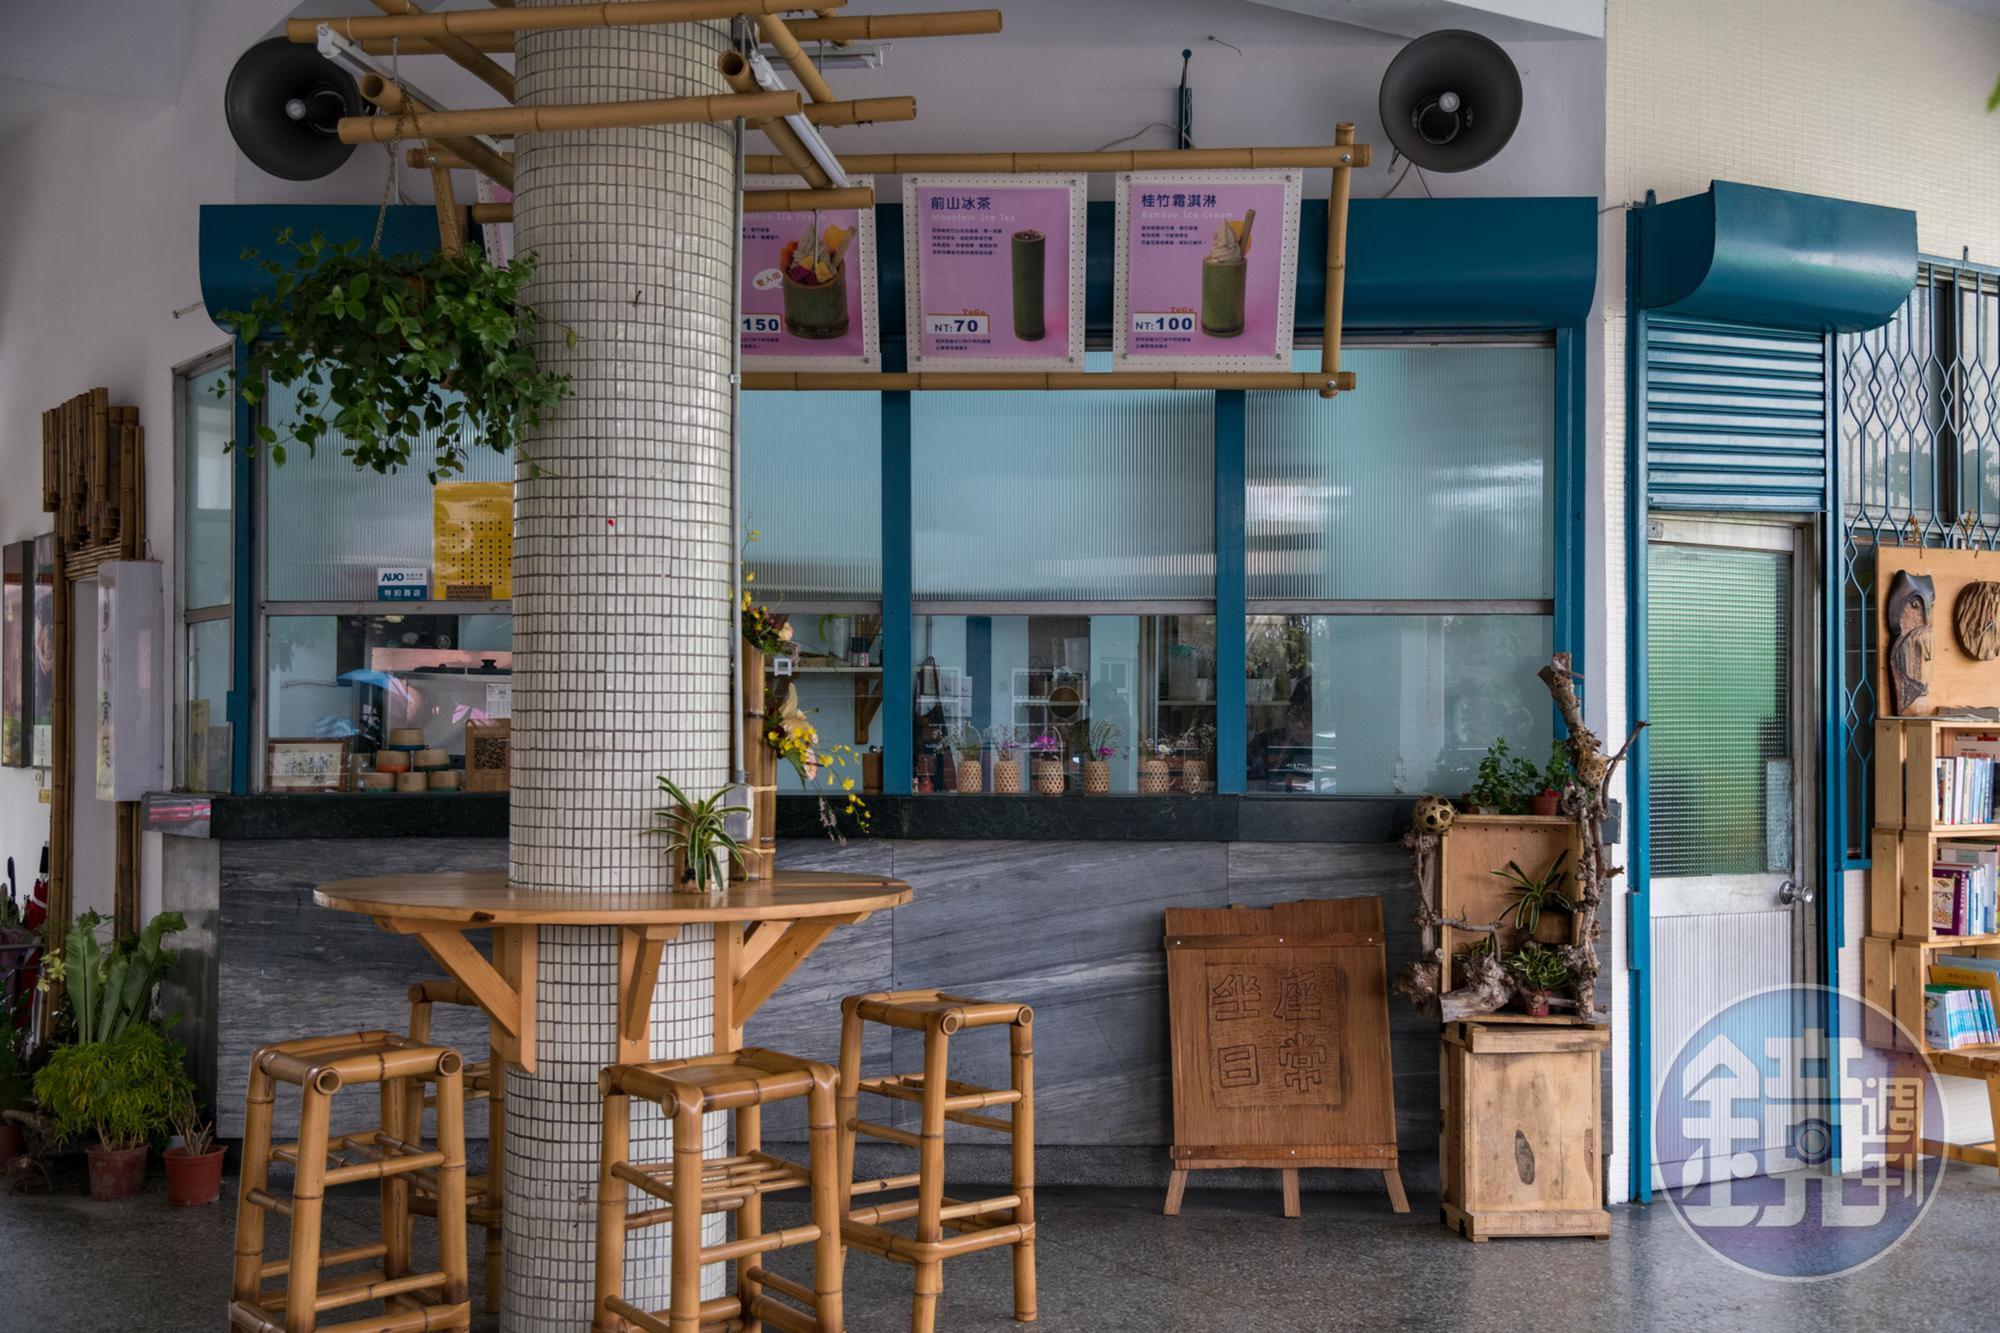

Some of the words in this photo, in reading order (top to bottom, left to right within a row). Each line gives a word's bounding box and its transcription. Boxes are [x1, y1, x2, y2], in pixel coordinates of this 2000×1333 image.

[930, 196, 991, 210] 前山冰茶
[1141, 193, 1217, 208] 桂竹霜淇淋
[931, 213, 976, 222] Mountain
[980, 213, 995, 222] Ice
[999, 213, 1016, 222] Tea
[1142, 210, 1179, 219] Bamboo
[1183, 210, 1198, 219] Ice
[1201, 210, 1233, 219] Cream
[934, 320, 978, 332] NT:70
[1135, 317, 1193, 330] NT:100
[381, 572, 405, 582] AUO
